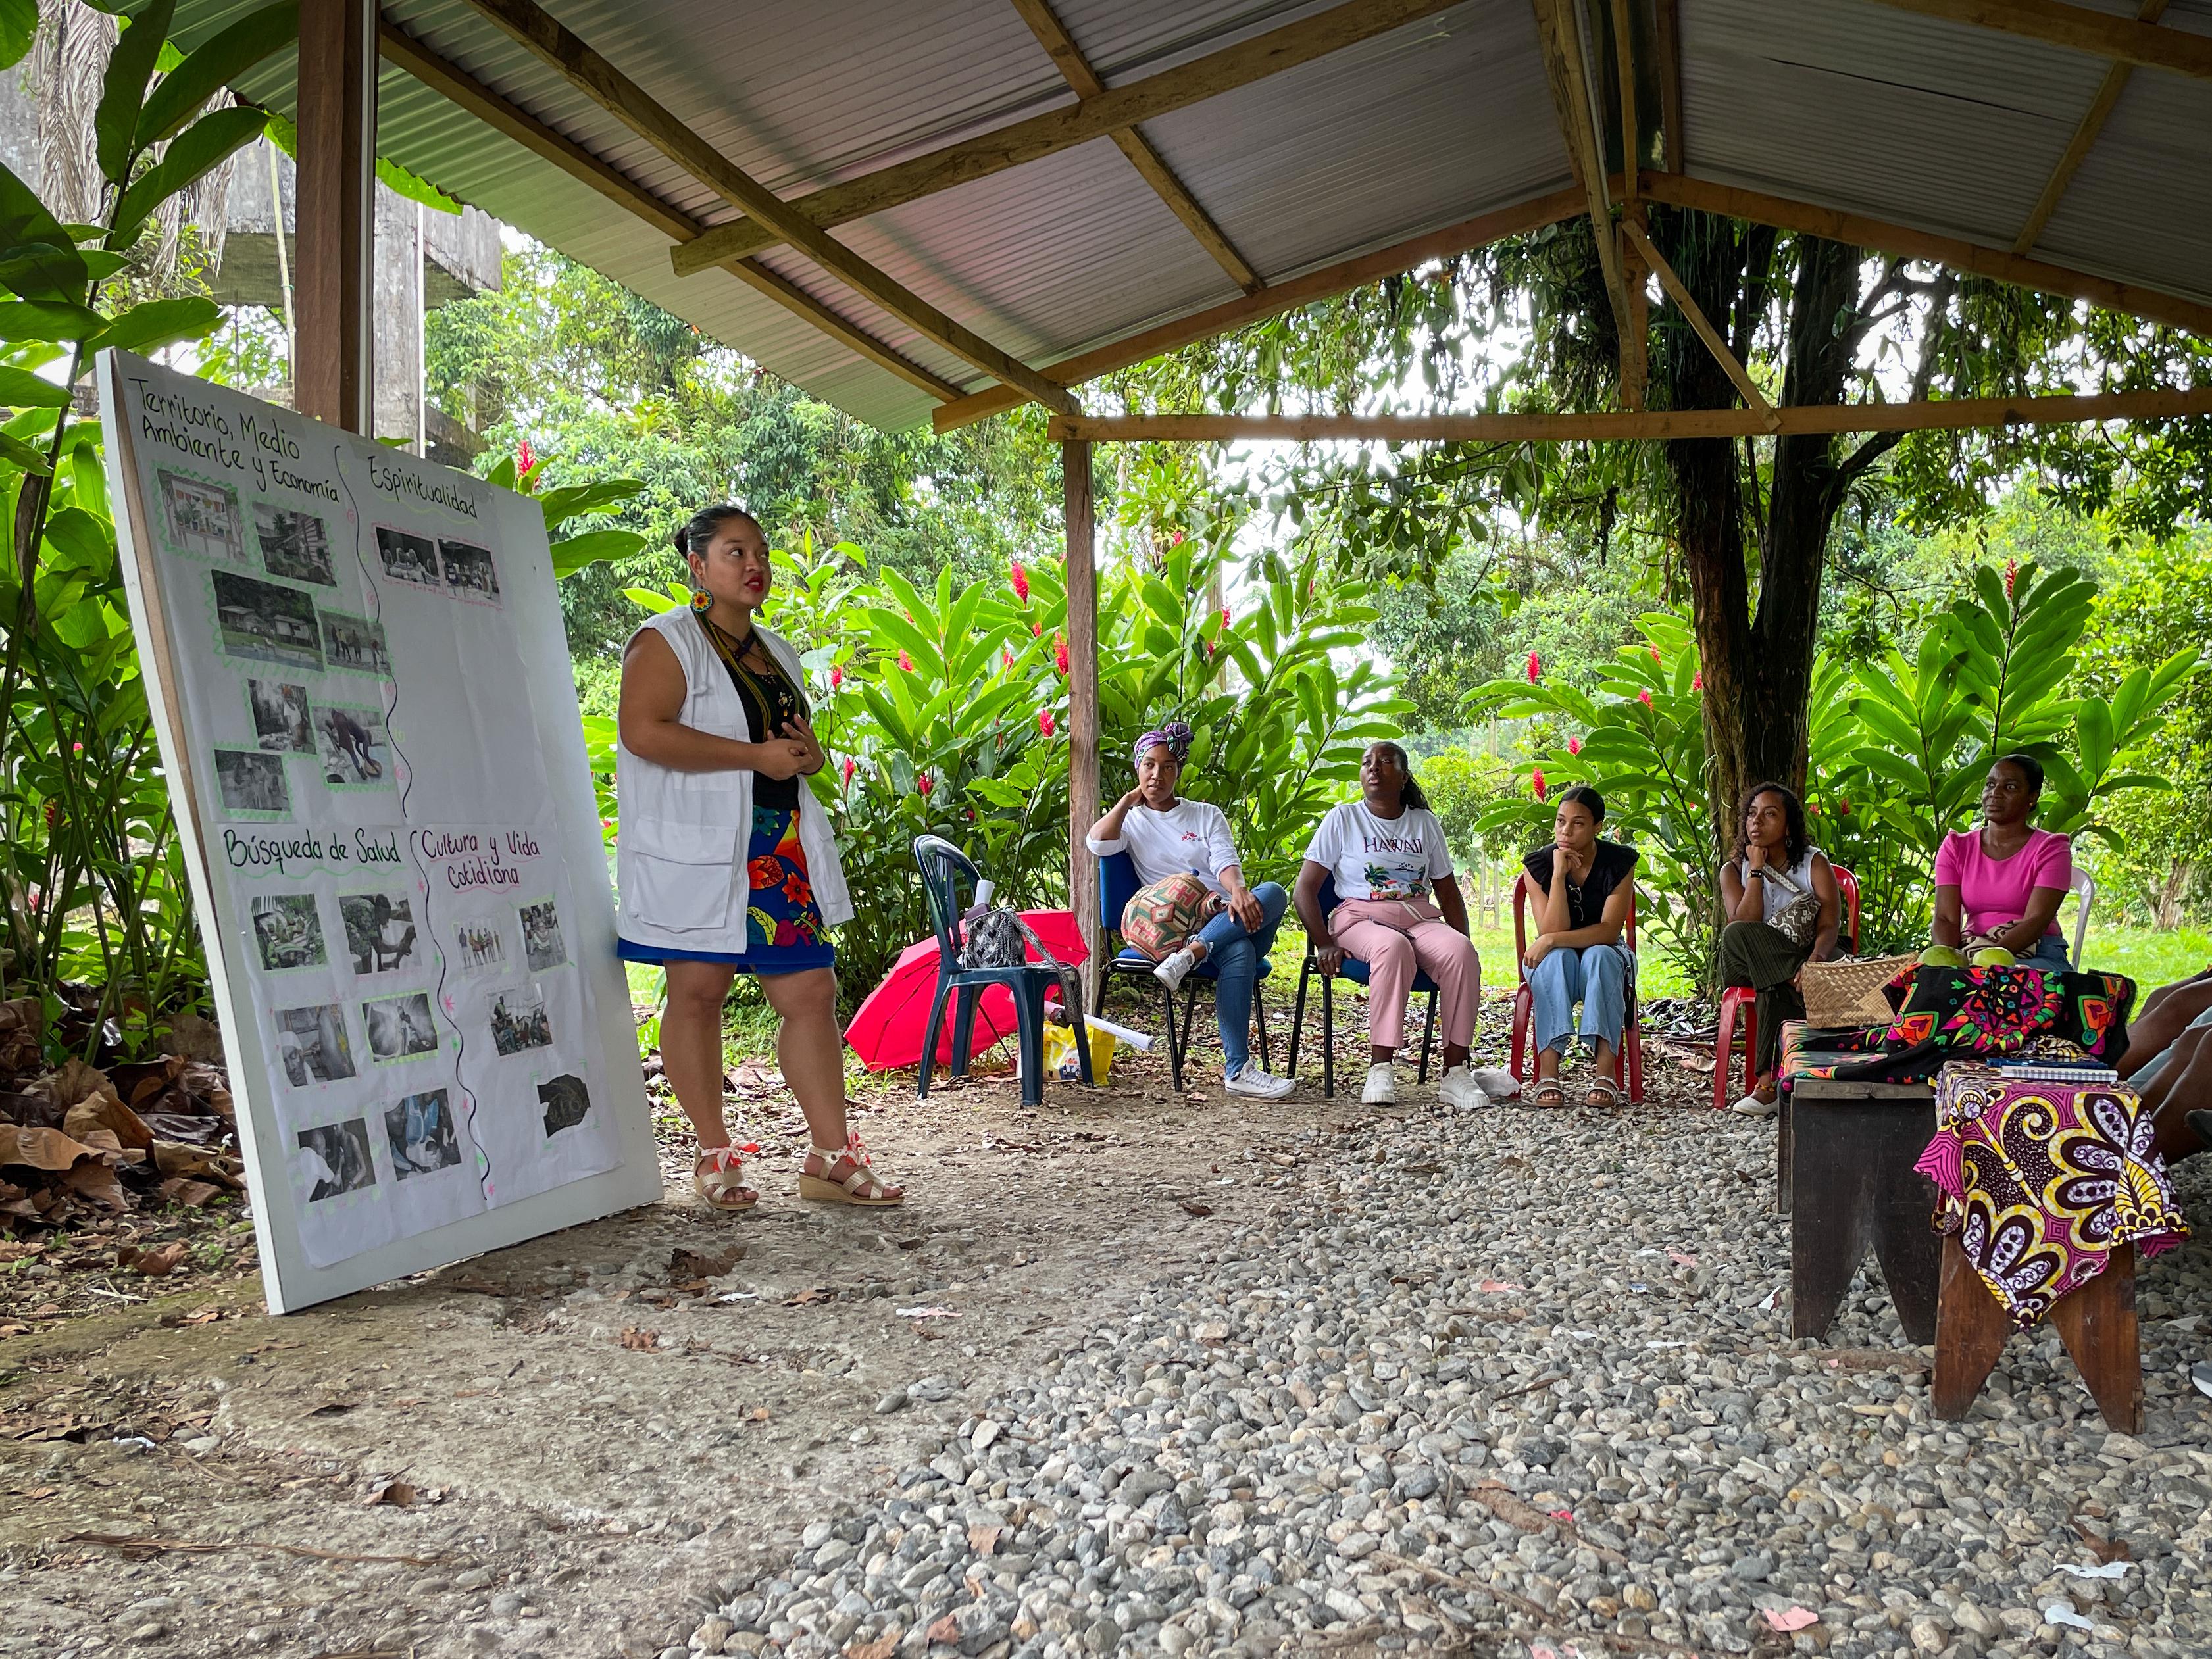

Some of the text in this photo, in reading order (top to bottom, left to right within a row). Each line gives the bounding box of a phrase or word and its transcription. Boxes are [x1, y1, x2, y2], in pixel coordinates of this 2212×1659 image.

[128, 378, 300, 460] Territorio, Medio
[143, 414, 340, 503] Ambiente y Economía
[368, 455, 478, 520] Espiritualidad
[223, 828, 401, 875] Búsqueda de Salud
[422, 830, 540, 866] Cultura y Vida
[1363, 836, 1423, 854] HAWAII
